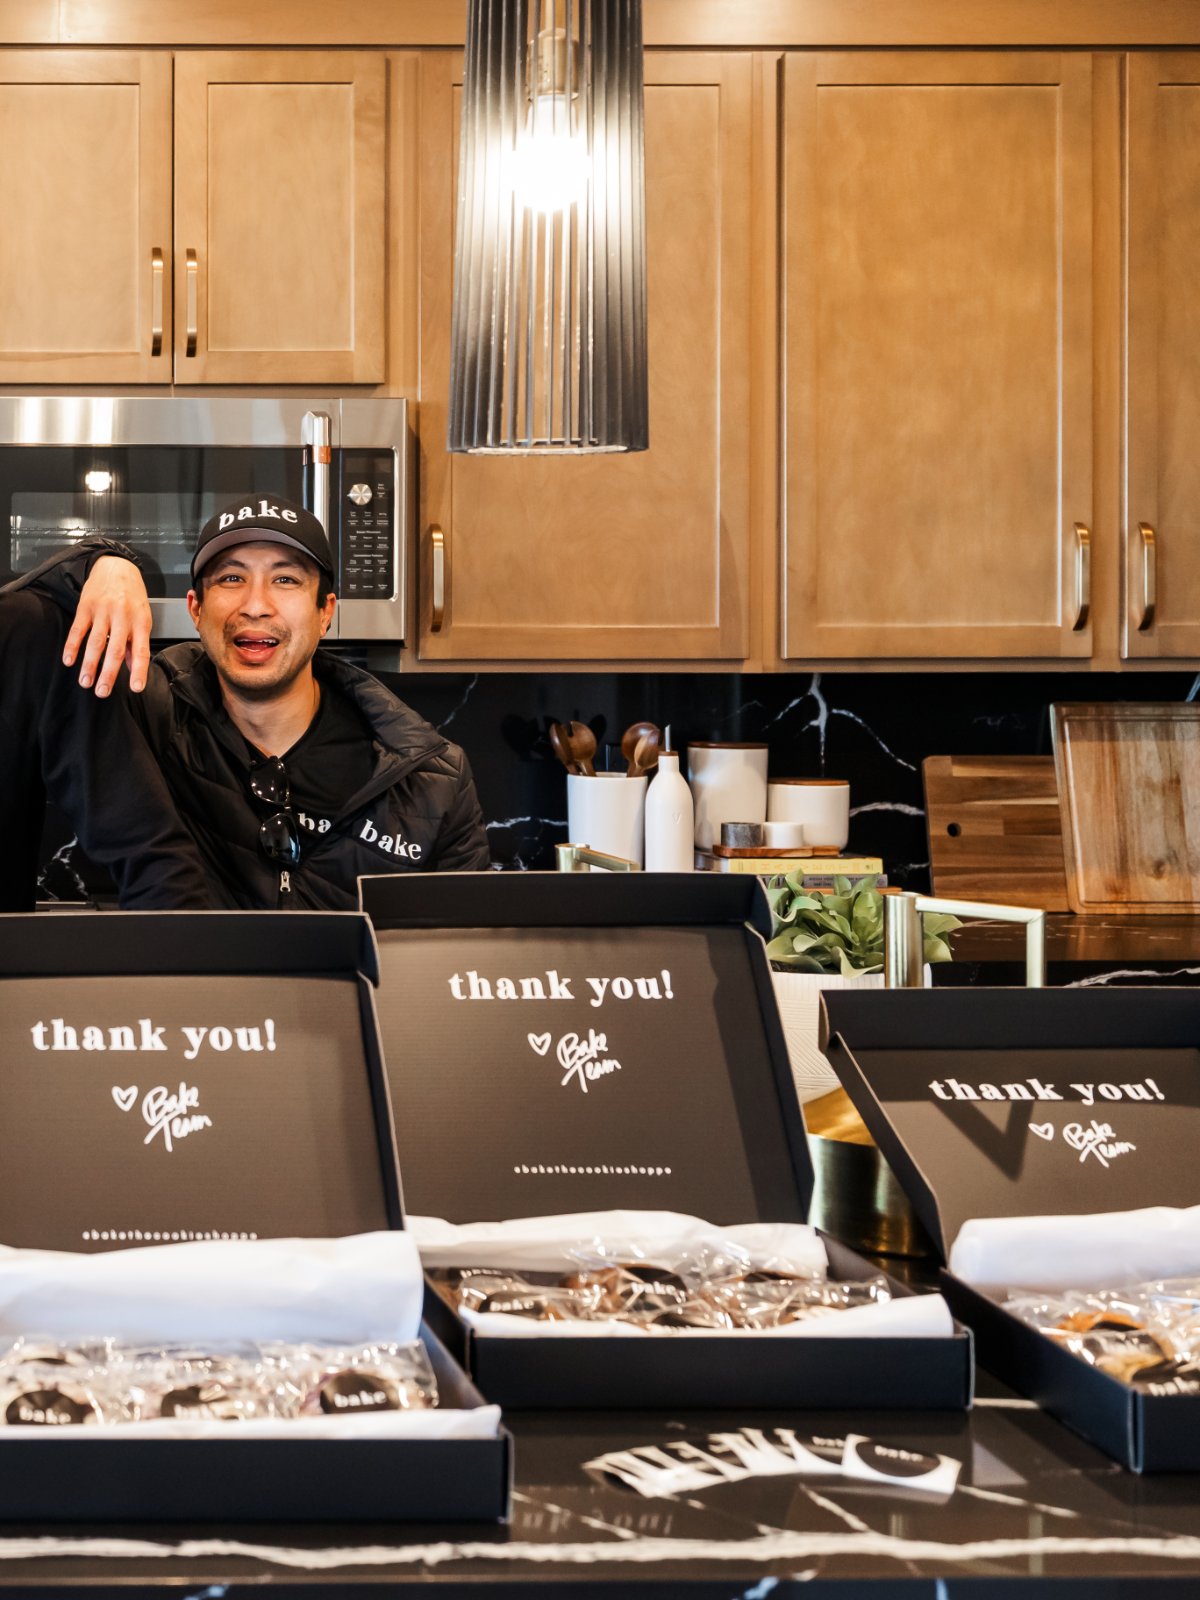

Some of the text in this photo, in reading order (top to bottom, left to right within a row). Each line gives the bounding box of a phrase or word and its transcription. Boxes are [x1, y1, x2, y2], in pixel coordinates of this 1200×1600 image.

[219, 500, 298, 531] bake
[298, 812, 332, 834] ba
[359, 819, 423, 861] bake
[448, 970, 675, 1007] thank you!
[30, 1018, 277, 1059] thank you!
[556, 1029, 609, 1070] Bake
[562, 1056, 622, 1094] Team
[142, 1081, 200, 1127] Bake
[928, 1077, 1166, 1107] thank you!
[143, 1112, 213, 1153] Team
[1062, 1119, 1117, 1150] Bake
[1078, 1140, 1137, 1169] Team
[490, 1298, 535, 1312] bake
[18, 1405, 72, 1425] bake
[333, 1390, 388, 1409] bake
[873, 1444, 924, 1463] bake
